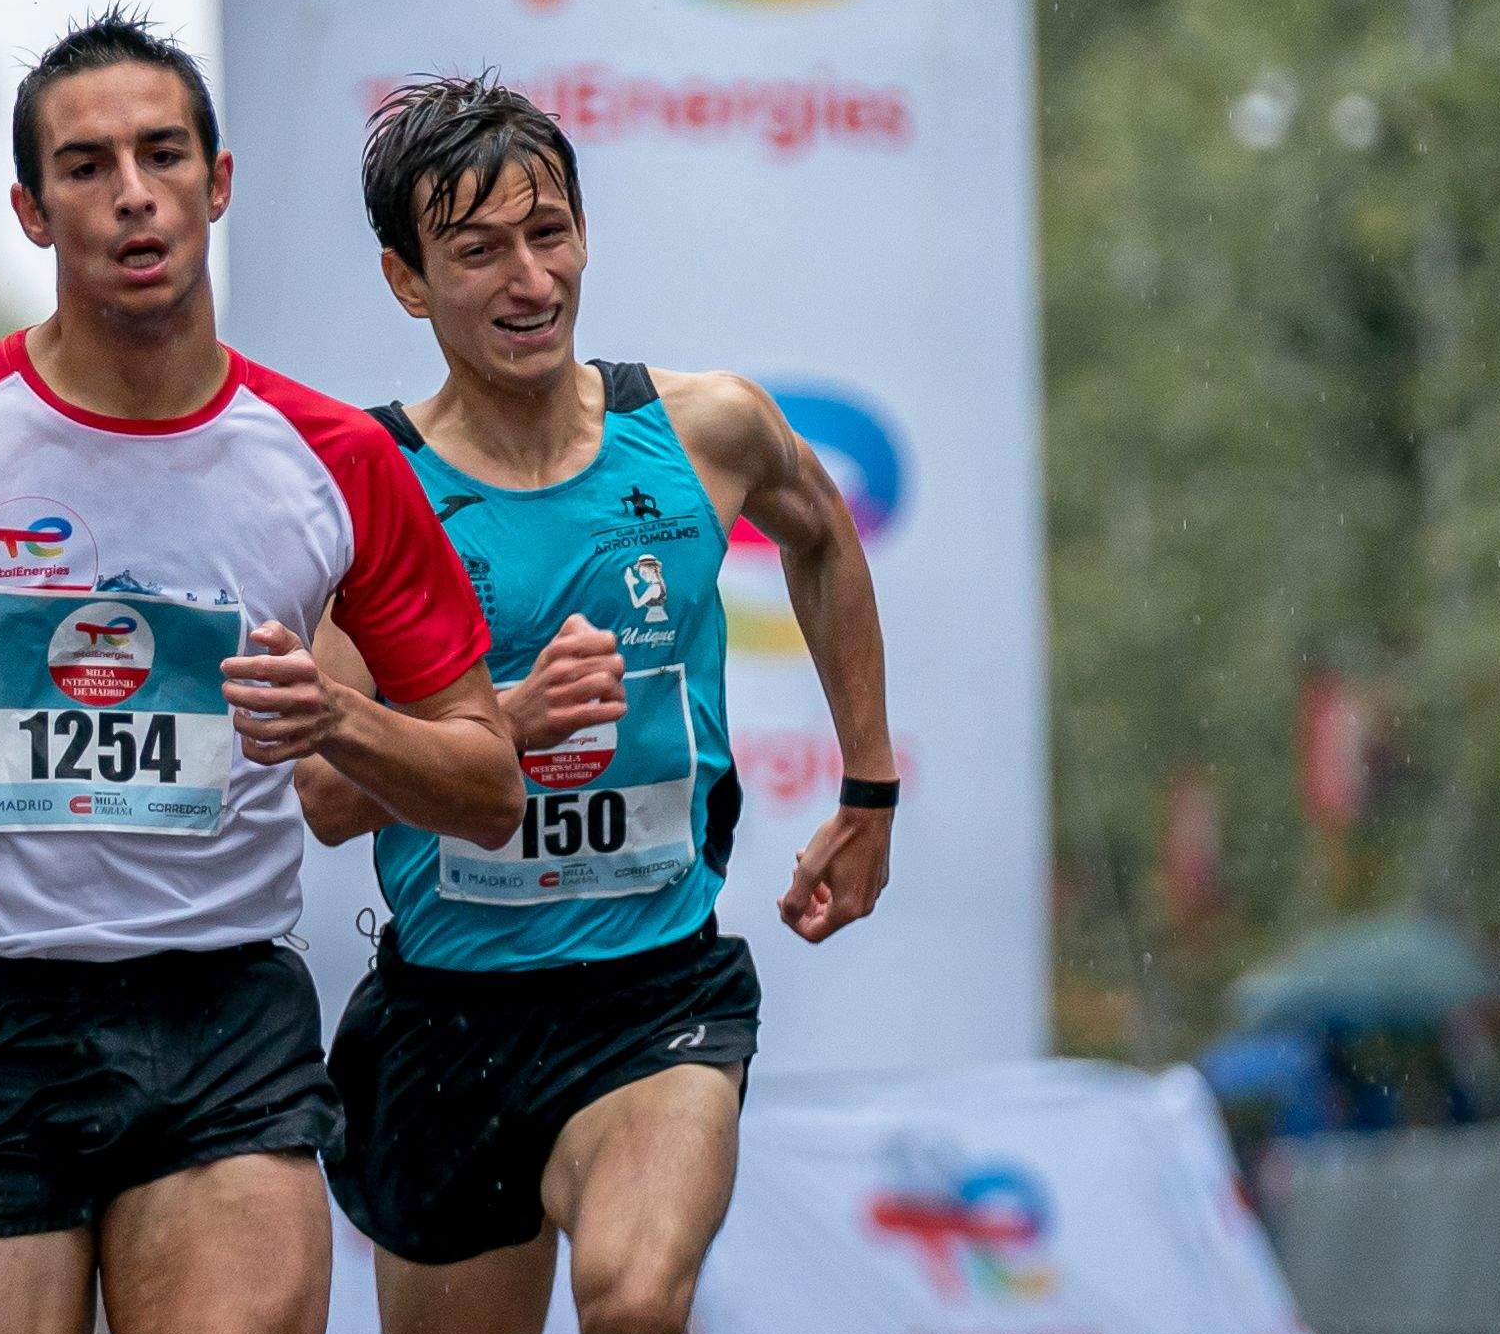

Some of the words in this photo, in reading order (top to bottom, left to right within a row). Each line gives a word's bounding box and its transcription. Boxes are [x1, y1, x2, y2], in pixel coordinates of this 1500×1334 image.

[594, 525, 700, 555] ARROYOMOLINOS
[621, 626, 676, 648] Unique
[85, 668, 115, 677] MILLA
[62, 677, 137, 689] INTERNACIONAL
[73, 687, 88, 696] DE
[89, 688, 126, 697] MADRID
[19, 709, 182, 784] 1254
[94, 795, 128, 806] MILLA
[522, 789, 627, 859] 150
